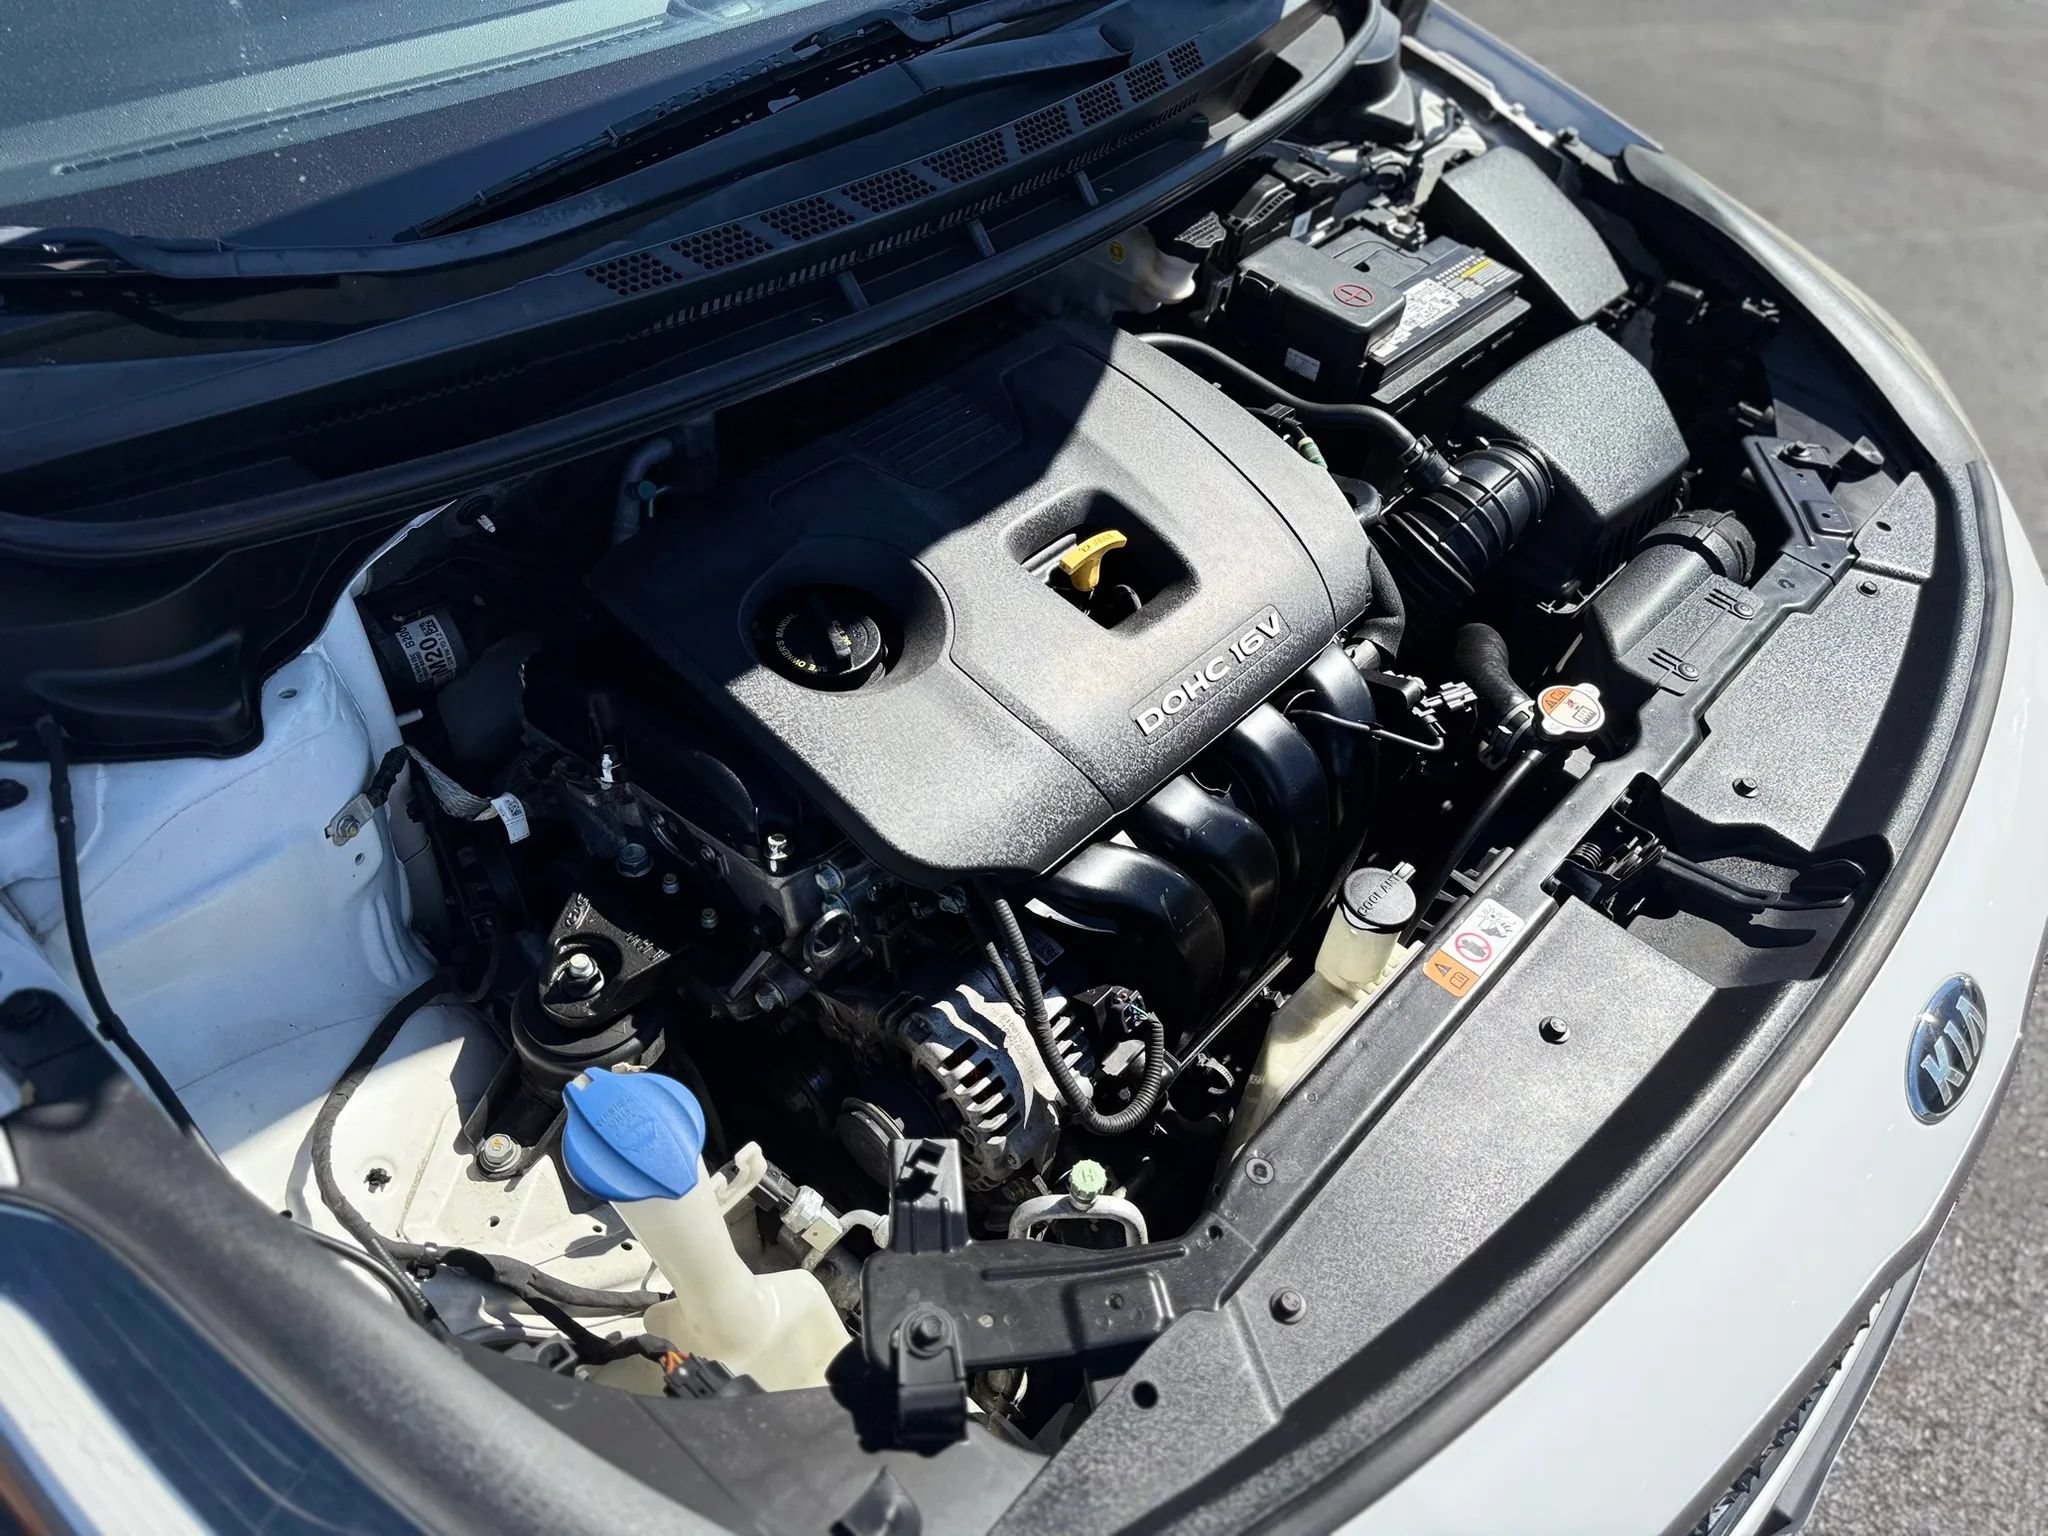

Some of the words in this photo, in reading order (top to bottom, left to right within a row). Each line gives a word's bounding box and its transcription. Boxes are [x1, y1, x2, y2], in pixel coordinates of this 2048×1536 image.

[776, 612, 799, 638] MANUA
[1134, 655, 1231, 737] DOHC
[1228, 612, 1281, 664] 16V
[1356, 873, 1400, 917] COOLANT
[1920, 995, 1986, 1106] KIA
